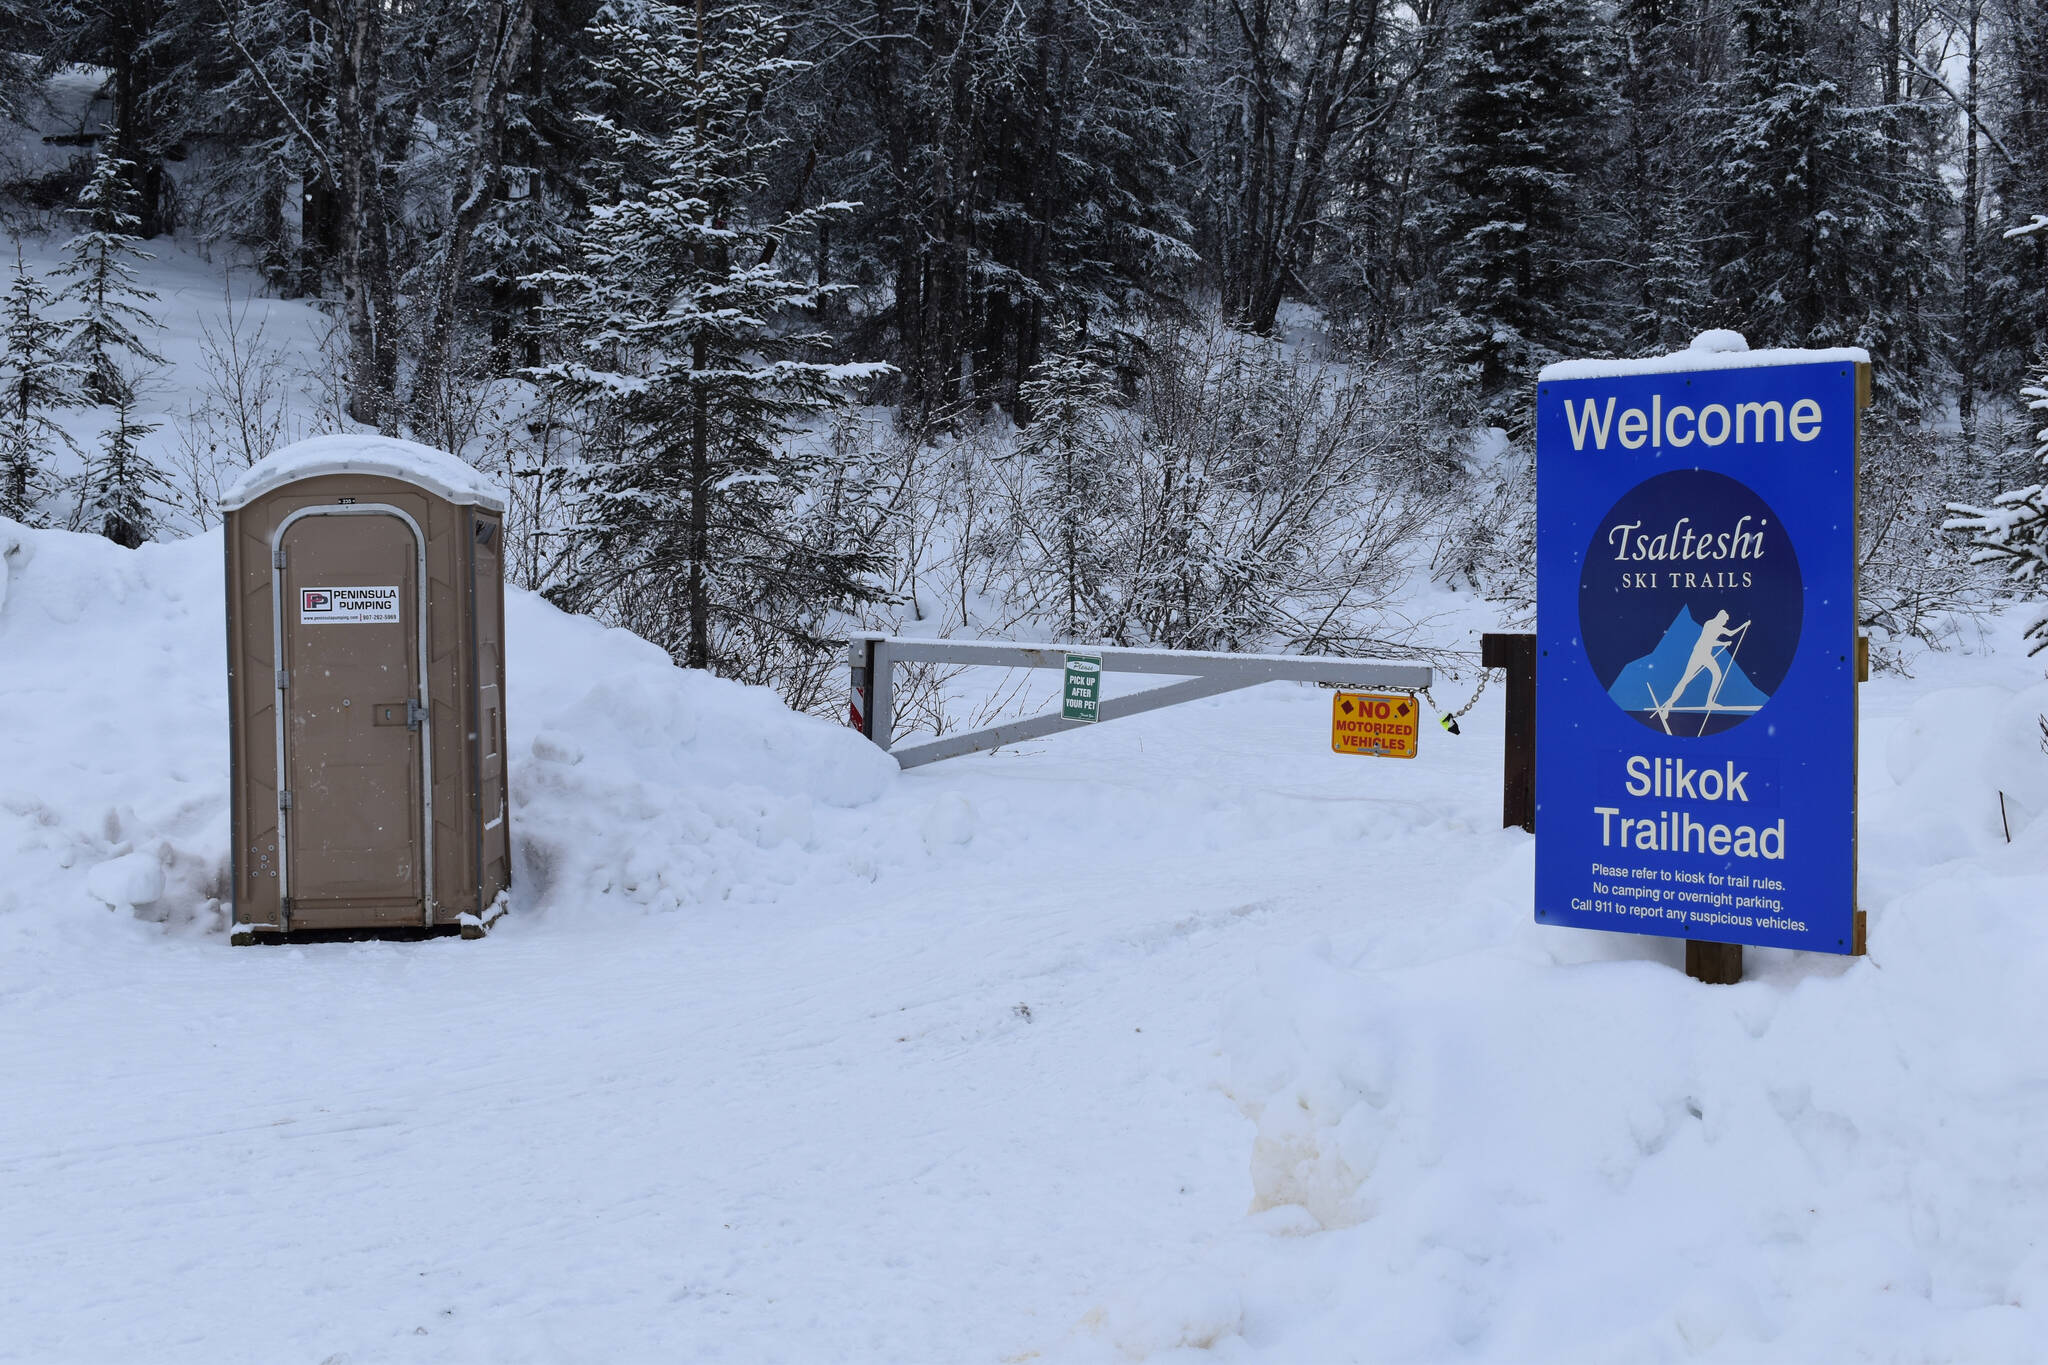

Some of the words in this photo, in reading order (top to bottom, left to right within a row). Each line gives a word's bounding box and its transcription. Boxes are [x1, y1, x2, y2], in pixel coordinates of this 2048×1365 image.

[1563, 394, 1823, 451] Welcome
[1608, 515, 1767, 561] Tsalteshi
[1622, 573, 1657, 589] SKI
[1669, 572, 1752, 588] TRAILS
[333, 589, 397, 599] PENINSULA
[339, 600, 392, 610] PUMPING
[1069, 675, 1085, 686] PICK
[1086, 676, 1096, 687] UP
[1071, 687, 1092, 698] AFTER
[1065, 698, 1083, 709] YOUR
[1084, 700, 1097, 710] PET
[1358, 701, 1391, 720] NO
[1336, 720, 1413, 736] MOTORIZED
[1342, 735, 1406, 750] VEHICLES
[1625, 755, 1749, 802] Slikok
[1594, 806, 1785, 860] Trailhead
[1592, 863, 1629, 878] Please
[1631, 867, 1658, 880] refer
[1660, 869, 1672, 881] to
[1674, 870, 1705, 884] kiosk
[1708, 872, 1724, 885] for
[1727, 874, 1750, 888] trail
[1752, 877, 1786, 891] rules.
[1593, 882, 1609, 894] No
[1611, 885, 1661, 902] camping
[1663, 890, 1675, 900] or
[1678, 891, 1733, 907] overnight
[1735, 896, 1785, 913] parking.
[1571, 898, 1592, 911] Call
[1594, 900, 1612, 913] 911
[1615, 903, 1627, 915] to
[1629, 905, 1663, 919] report
[1666, 909, 1687, 923] any
[1690, 911, 1753, 927] suspicious
[1755, 916, 1809, 932] vehicles.
